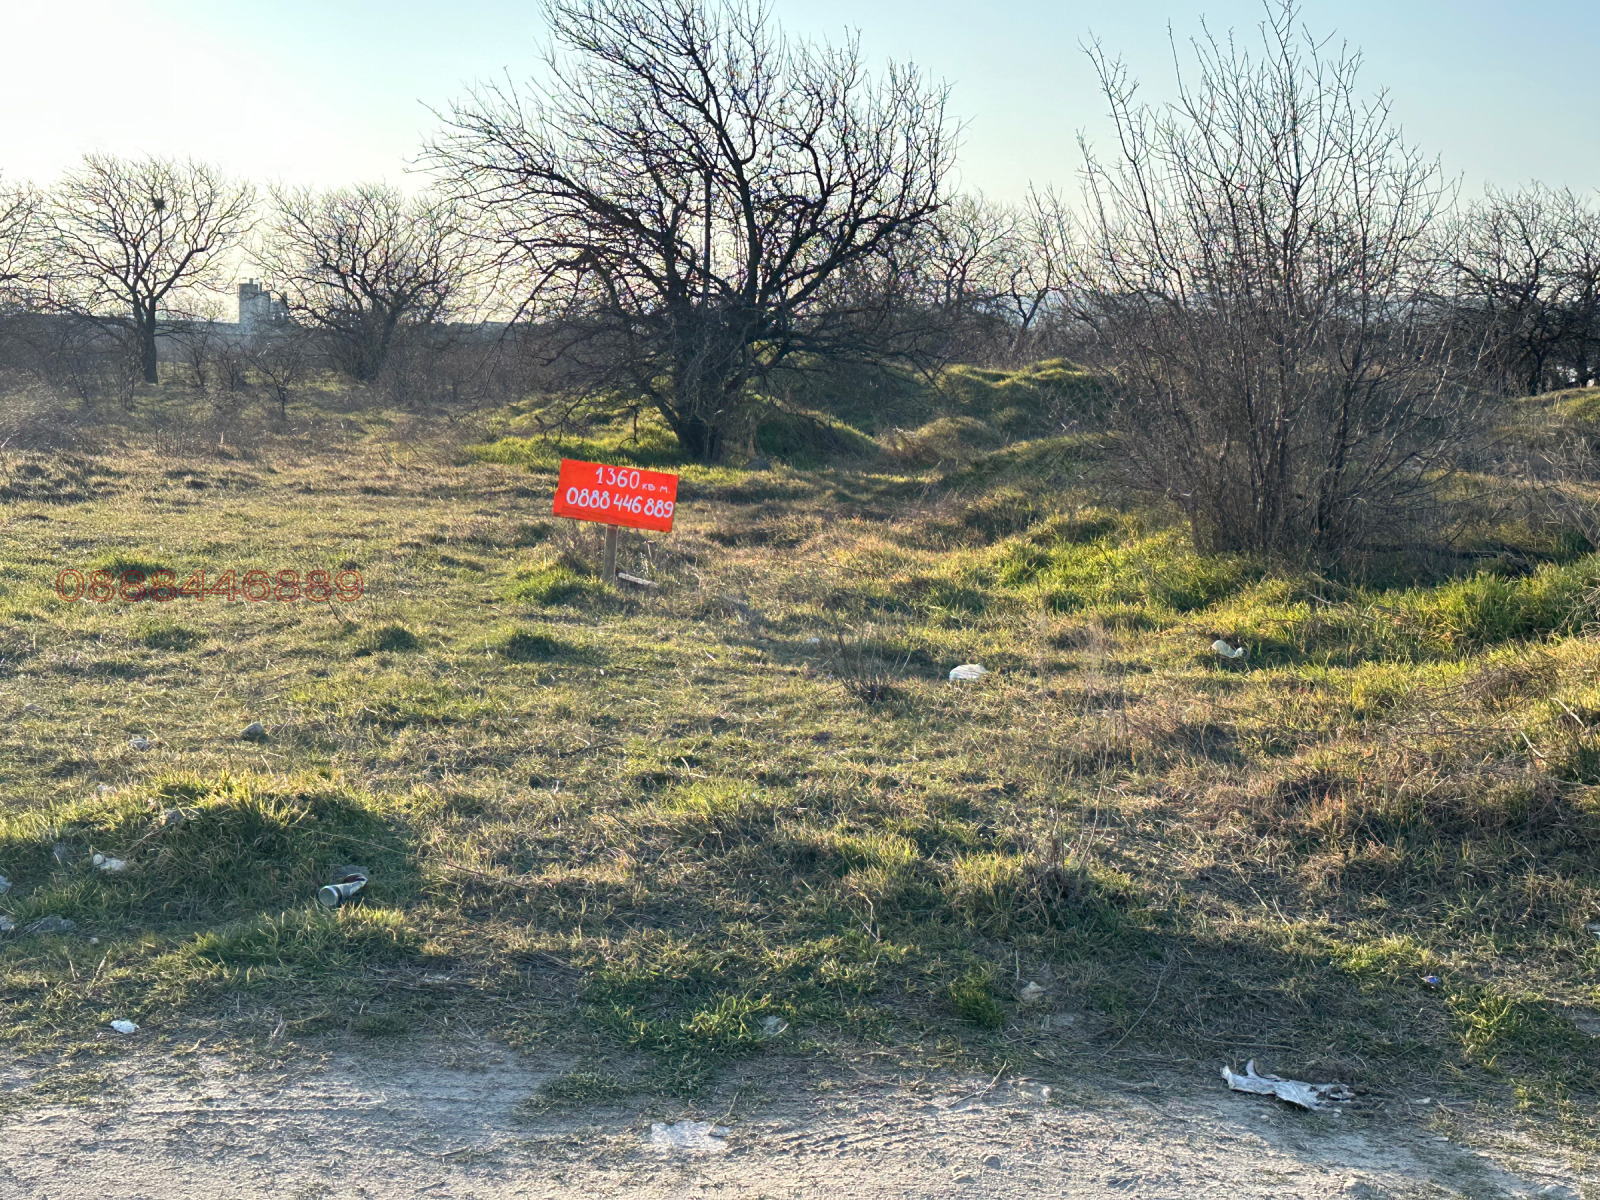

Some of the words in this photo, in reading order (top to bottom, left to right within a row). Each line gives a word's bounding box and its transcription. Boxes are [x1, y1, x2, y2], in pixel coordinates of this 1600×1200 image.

[596, 466, 640, 489] 1360
[566, 487, 610, 509] 0888
[613, 494, 643, 513] 446
[644, 498, 674, 518] 889
